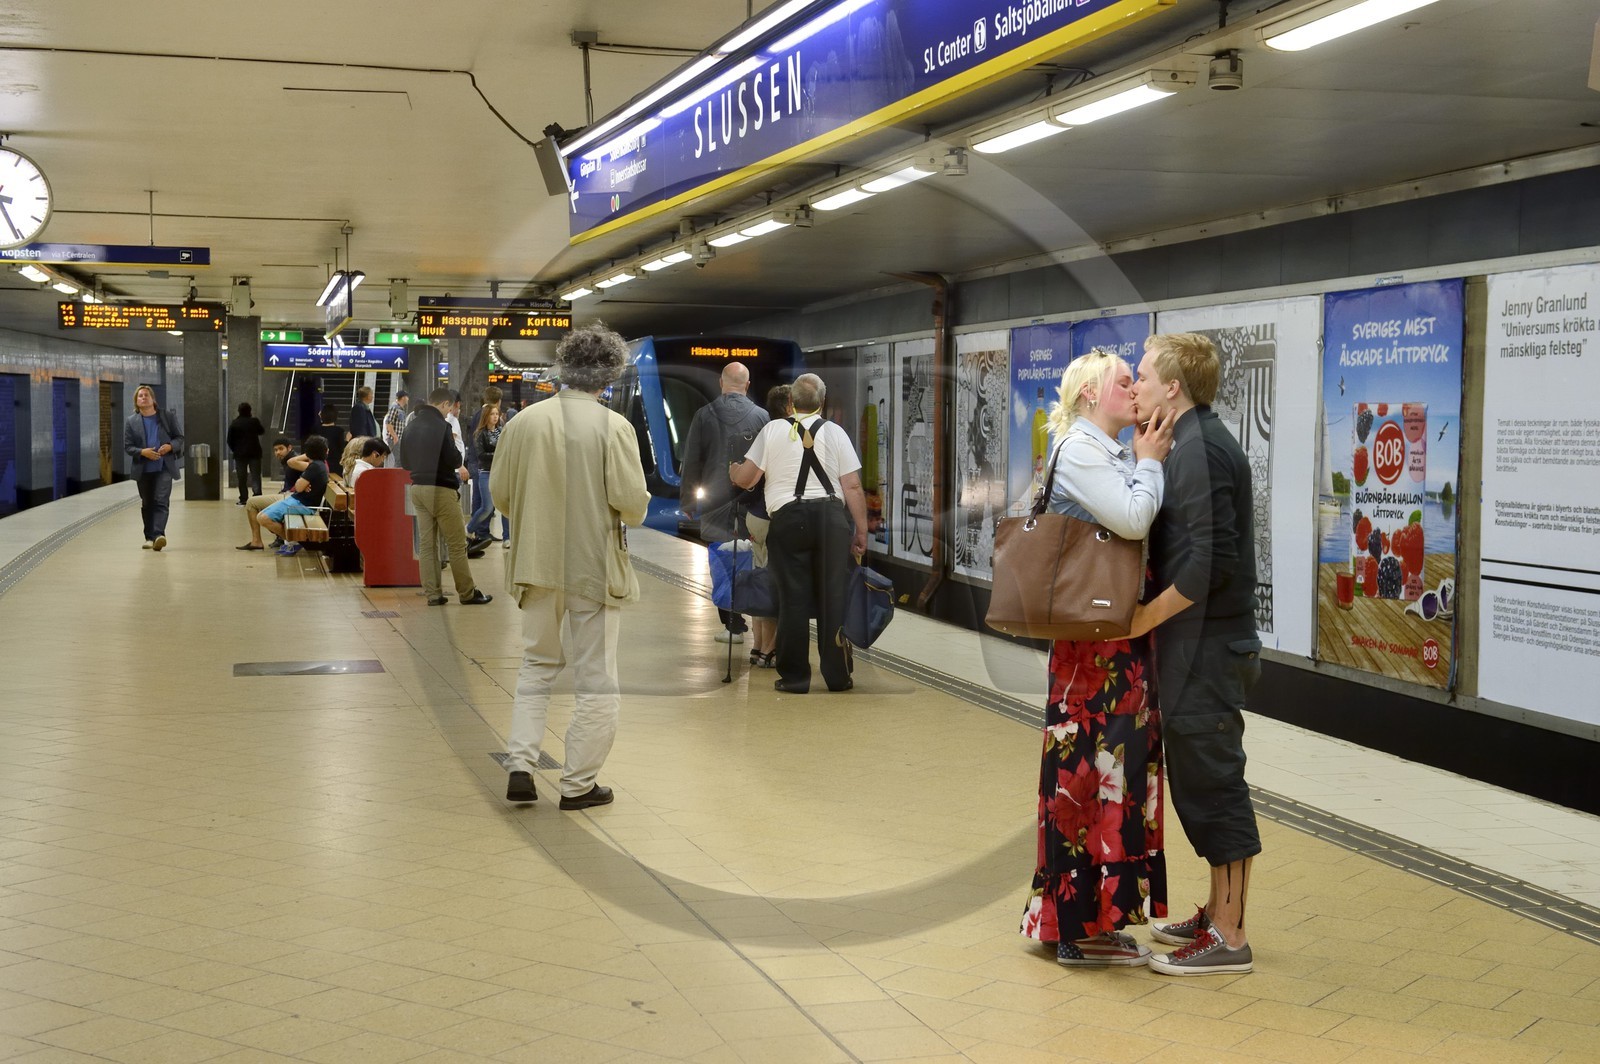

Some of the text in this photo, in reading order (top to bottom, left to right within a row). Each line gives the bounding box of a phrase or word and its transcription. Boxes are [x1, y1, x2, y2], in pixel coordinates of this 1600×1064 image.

[924, 33, 972, 74] SL Center
[694, 50, 802, 158] SLUSSEN
[1, 248, 41, 260] Ropsten
[60, 304, 73, 314] 14
[84, 304, 118, 317] Mörby
[122, 306, 168, 317] centrum
[190, 308, 209, 318] min
[1502, 292, 1588, 318] Jenny Granlund
[82, 316, 130, 328] Ropsten
[157, 318, 176, 328] min
[492, 316, 512, 326] str.
[1352, 316, 1436, 340] SVERIGES MEST
[1562, 317, 1596, 333] krökta
[470, 328, 487, 336] min
[731, 348, 758, 356] strand
[1030, 348, 1053, 362] SVERIGES
[1339, 340, 1450, 367] ÄLSKADE LÄTTDRYCK
[1500, 342, 1546, 359] mänskliga
[1018, 364, 1052, 381] POPULÄRASTE
[1376, 438, 1402, 469] BOB
[1398, 492, 1423, 505] HALLON
[1373, 505, 1404, 520] LÄTTDRYCK
[1351, 635, 1377, 649] SMAKEN
[1378, 642, 1388, 652] AV
[1424, 646, 1438, 660] BOB
